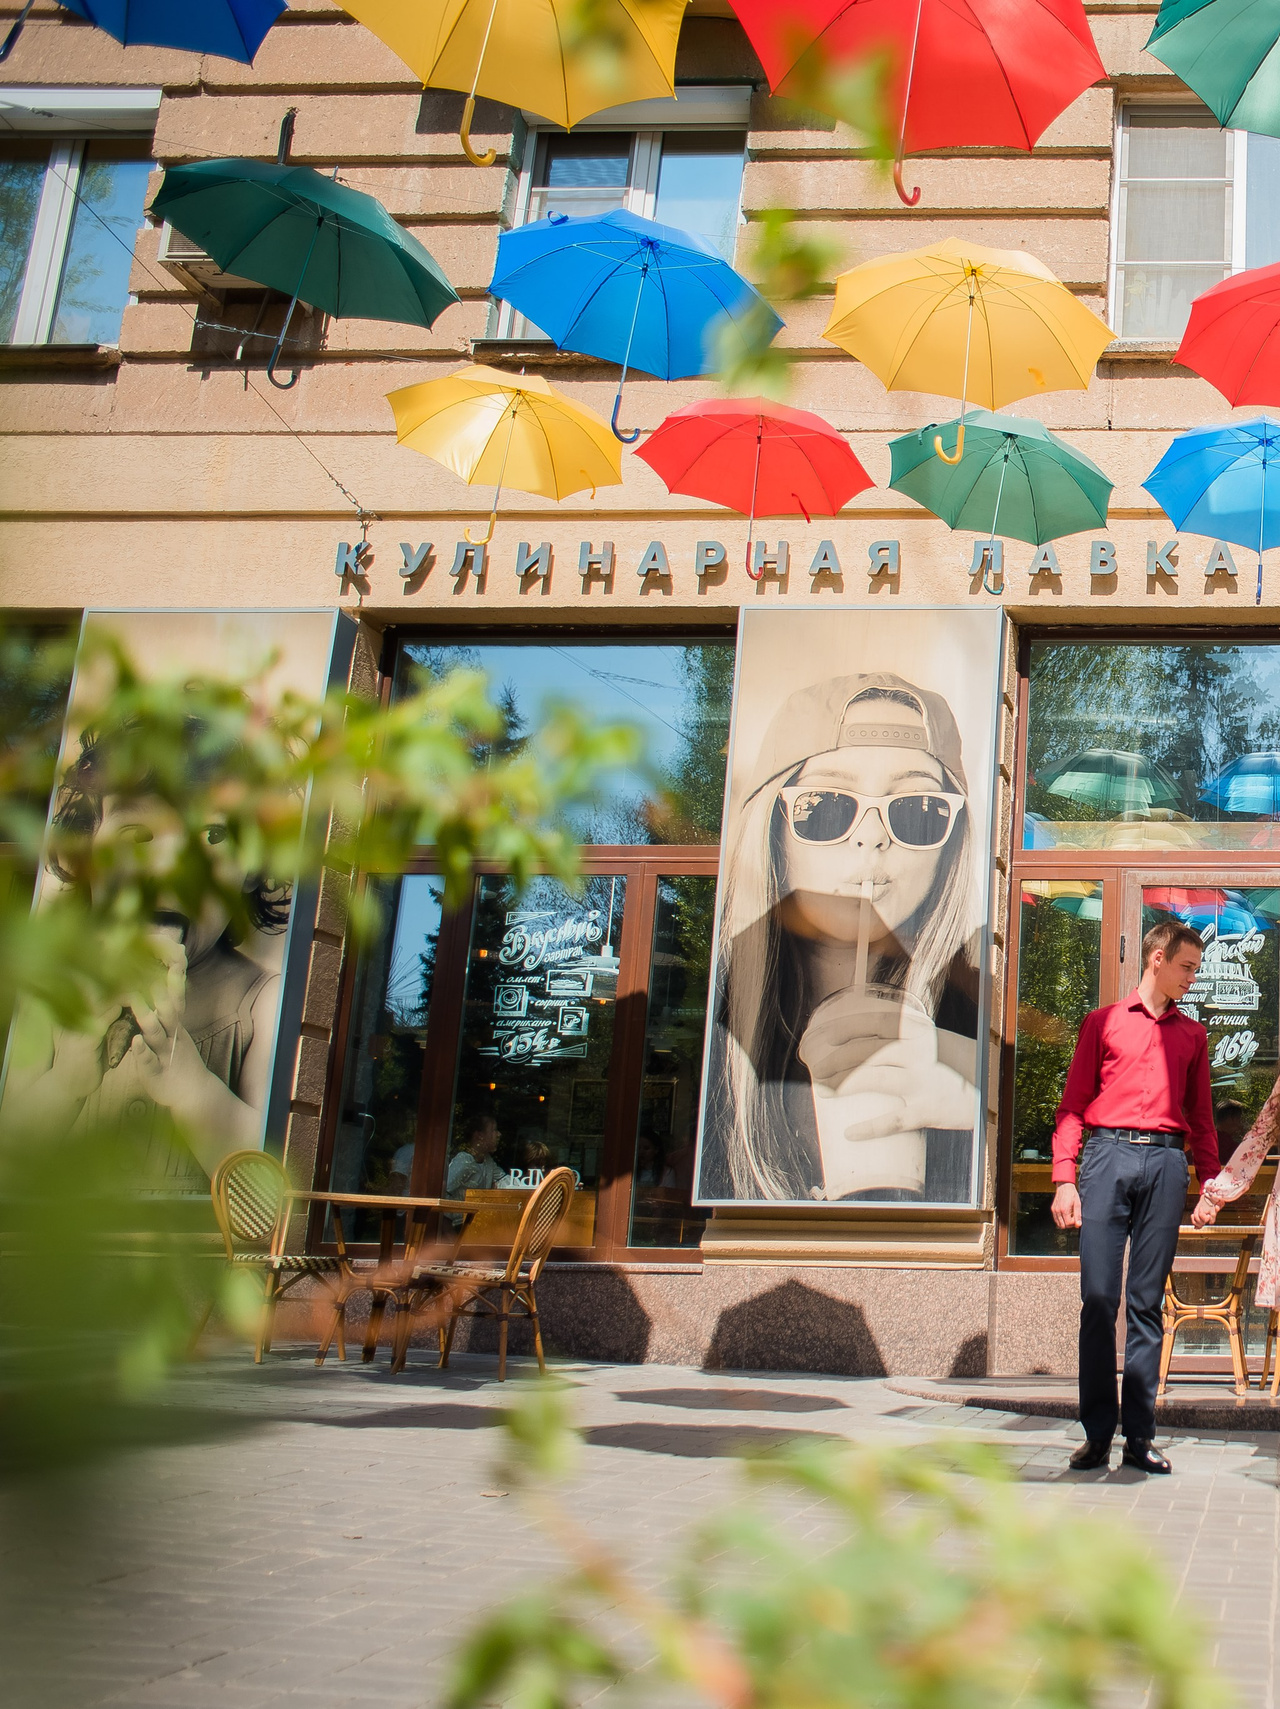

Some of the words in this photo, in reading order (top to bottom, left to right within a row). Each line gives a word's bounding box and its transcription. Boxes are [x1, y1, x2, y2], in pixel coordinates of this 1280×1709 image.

[334, 540, 900, 577] КУЛИНАРНАЯ
[967, 540, 1238, 577] ЛАВКА
[506, 976, 541, 984] омлет
[1189, 982, 1214, 992] ница
[1209, 1015, 1250, 1025] сочник
